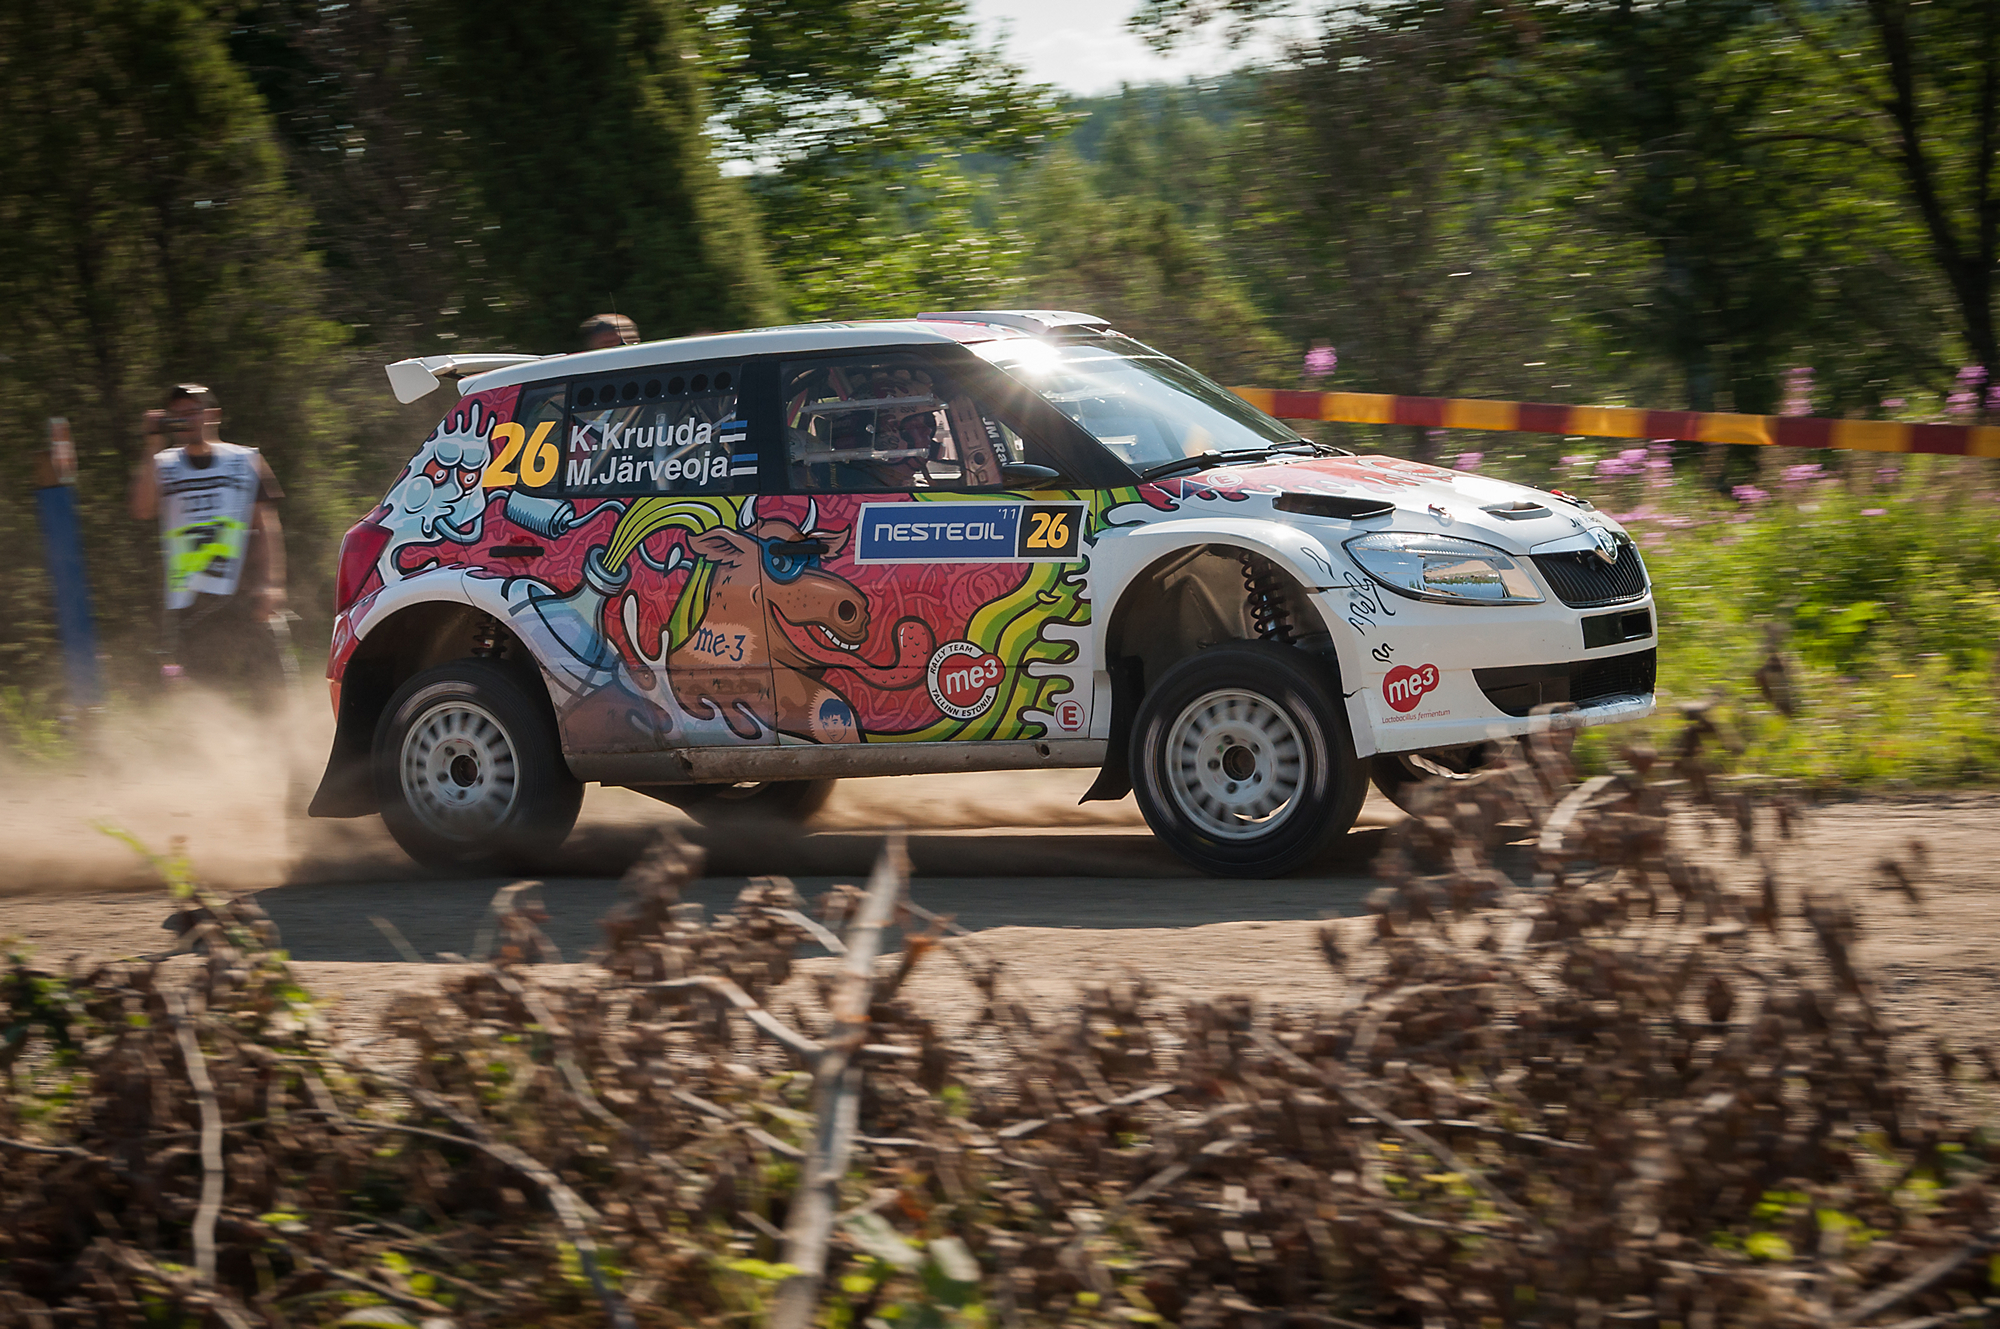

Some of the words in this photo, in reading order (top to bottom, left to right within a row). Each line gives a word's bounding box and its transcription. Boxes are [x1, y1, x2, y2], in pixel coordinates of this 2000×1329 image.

[569, 417, 712, 453] K.Kruuda
[982, 417, 1000, 439] JM
[481, 421, 560, 488] 26
[565, 451, 729, 487] M.Järveoja
[874, 522, 1005, 542] NESTEOIL
[1026, 512, 1070, 549] 26
[930, 649, 946, 675] RALLY
[948, 644, 973, 653] TEAM
[946, 659, 998, 695] me3
[931, 688, 960, 716] TALLINN
[961, 694, 992, 717] ESTONIA
[1388, 667, 1434, 704] me3
[1062, 706, 1078, 725] E
[1381, 713, 1417, 724] Lactobacillus
[1417, 709, 1451, 721] fermentum
